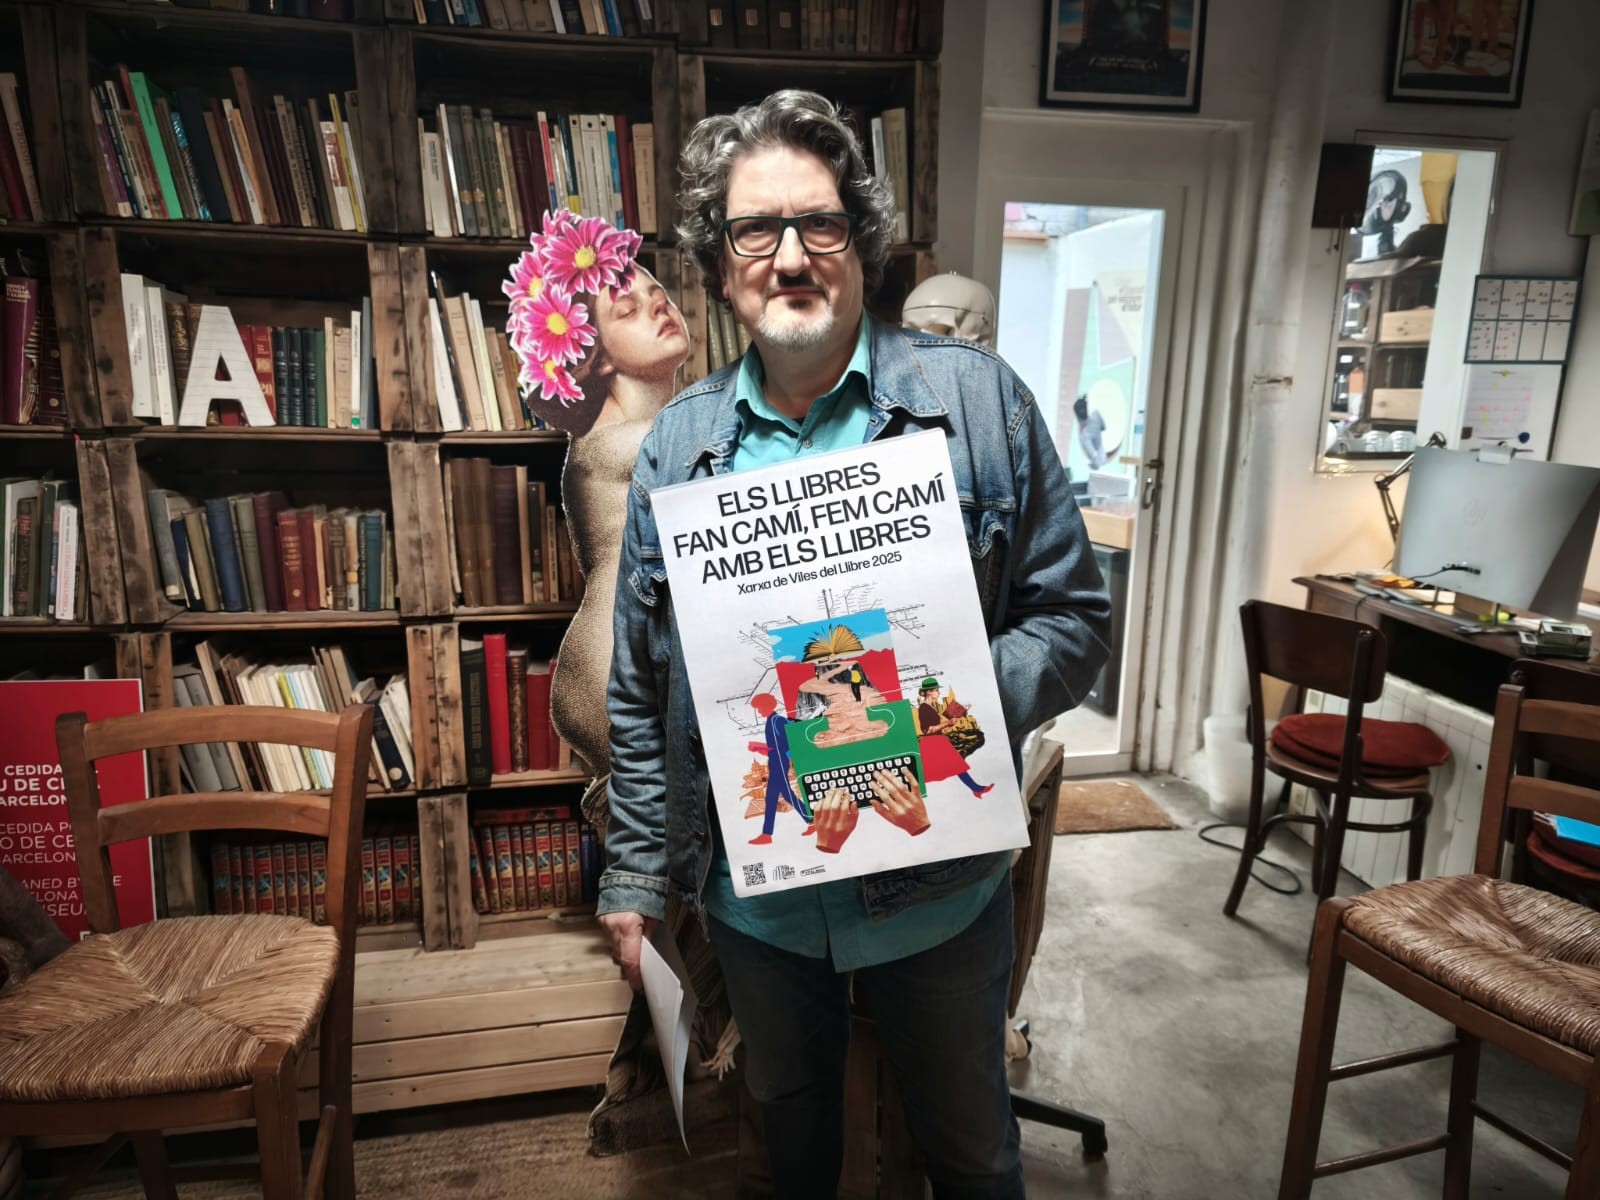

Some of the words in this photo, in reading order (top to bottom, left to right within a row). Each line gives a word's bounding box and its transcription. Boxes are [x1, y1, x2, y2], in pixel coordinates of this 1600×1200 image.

[178, 305, 277, 428] A
[673, 525, 728, 558] FAN
[731, 503, 809, 545] CAMÍ,
[810, 495, 869, 529] FEM
[872, 472, 945, 515] CAMÍ
[717, 485, 768, 517] ELS
[771, 461, 881, 506] LLIBRES
[702, 550, 764, 584] AMB
[767, 538, 818, 570] ELS
[820, 514, 931, 558] LLIBRES
[737, 580, 772, 595] Xarxa
[773, 576, 788, 589] de
[789, 571, 818, 584] Viles
[819, 565, 838, 578] del
[838, 559, 871, 574] Llibre
[871, 551, 902, 567] 2025
[14, 778, 40, 791] DE
[20, 835, 46, 849] DE
